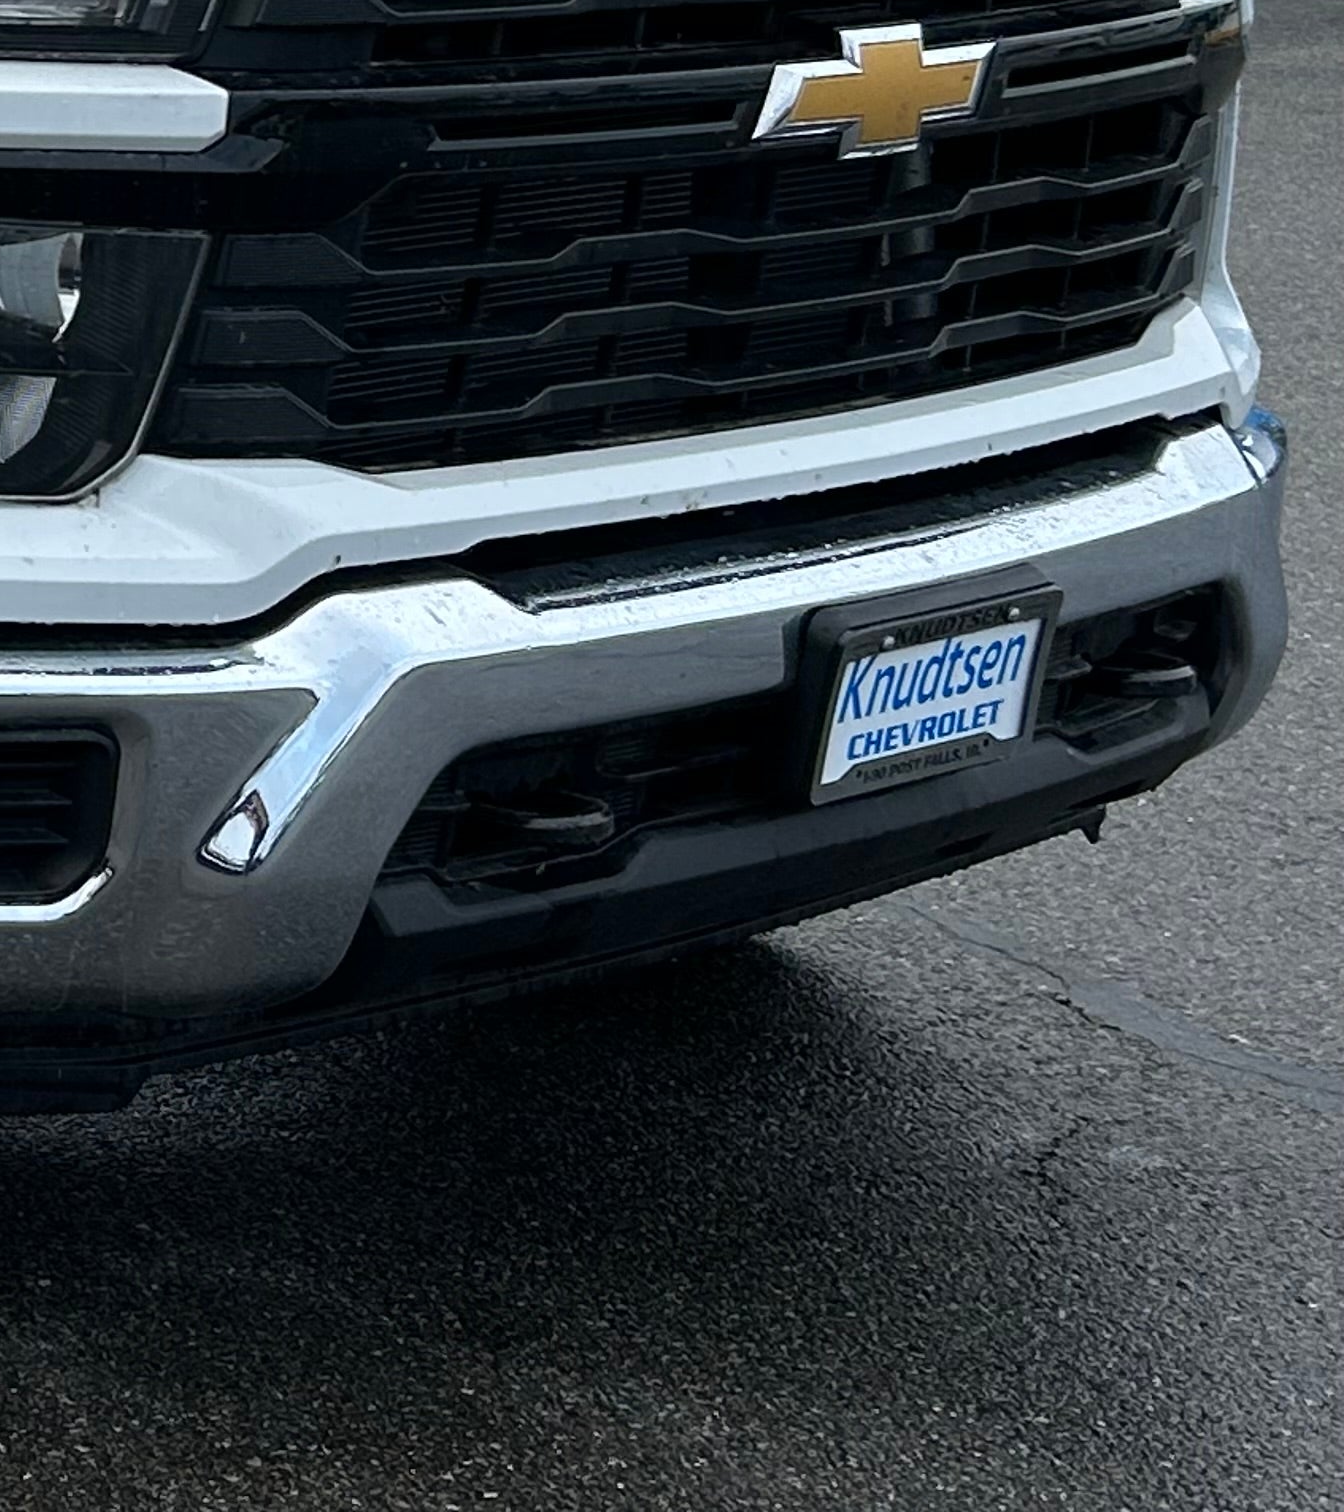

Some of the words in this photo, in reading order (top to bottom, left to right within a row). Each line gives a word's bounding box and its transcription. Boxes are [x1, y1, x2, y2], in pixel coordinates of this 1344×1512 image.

[894, 602, 1010, 648] KNUDTSEN
[836, 632, 1027, 724] Knudtsen
[846, 699, 1005, 761] CHEVROLET
